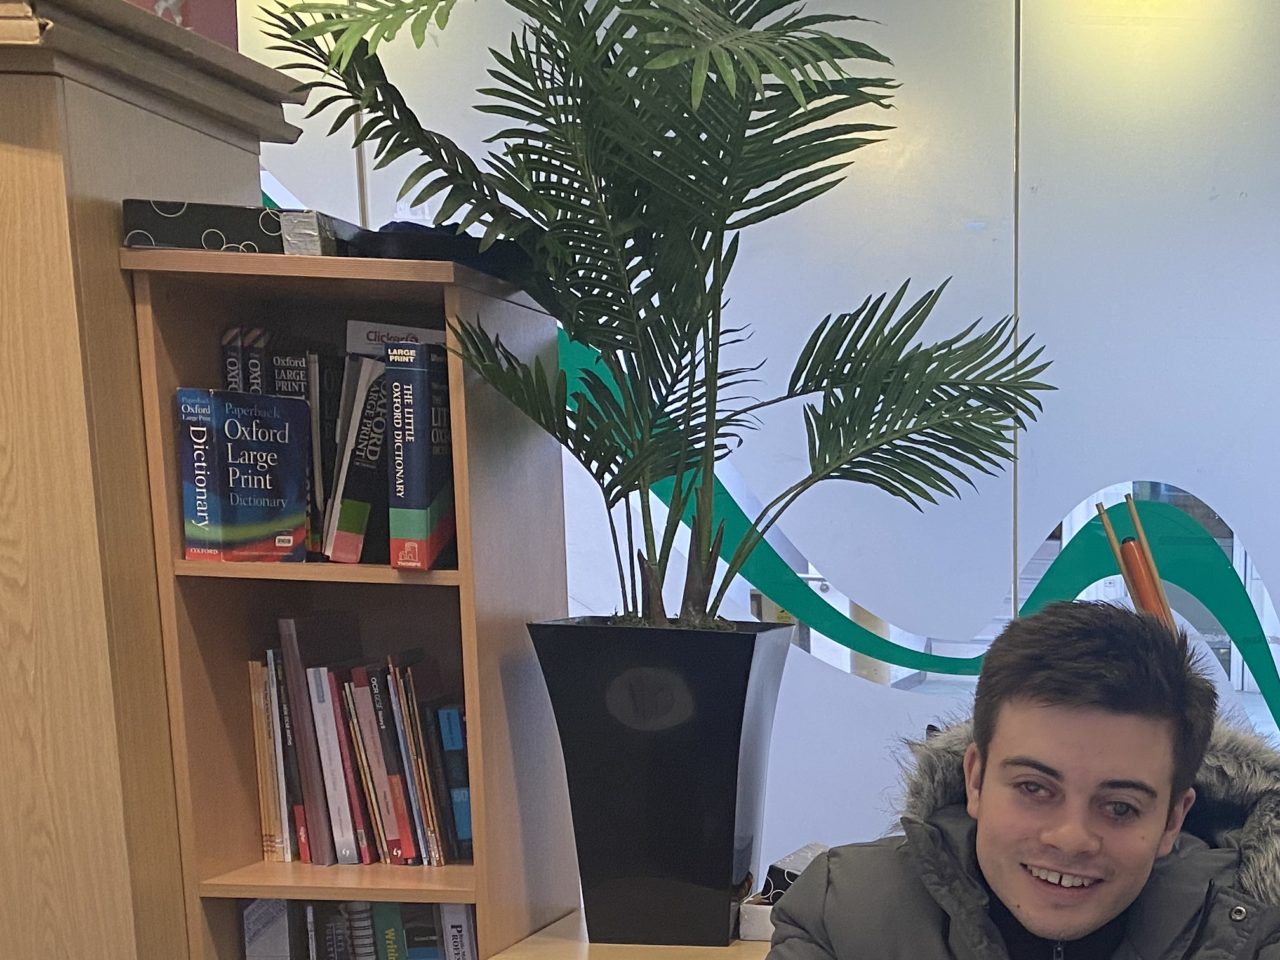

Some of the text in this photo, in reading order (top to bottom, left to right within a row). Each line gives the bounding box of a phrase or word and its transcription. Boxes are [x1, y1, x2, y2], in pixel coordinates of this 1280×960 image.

[273, 356, 306, 367] Oxford
[388, 348, 416, 356] LARGE
[274, 369, 306, 380] LARGE
[275, 381, 306, 392] PRINT
[182, 404, 210, 414] Oxford
[225, 402, 280, 418] Paperback
[403, 384, 415, 442] THE LITTLE
[225, 418, 289, 443] Oxford
[356, 418, 372, 459] PRINT
[392, 382, 404, 498] OXFORD DICTIONARY
[227, 443, 278, 471] Large
[190, 426, 210, 531] Dictionary
[229, 467, 273, 489] Print
[230, 493, 288, 512] Dictionary
